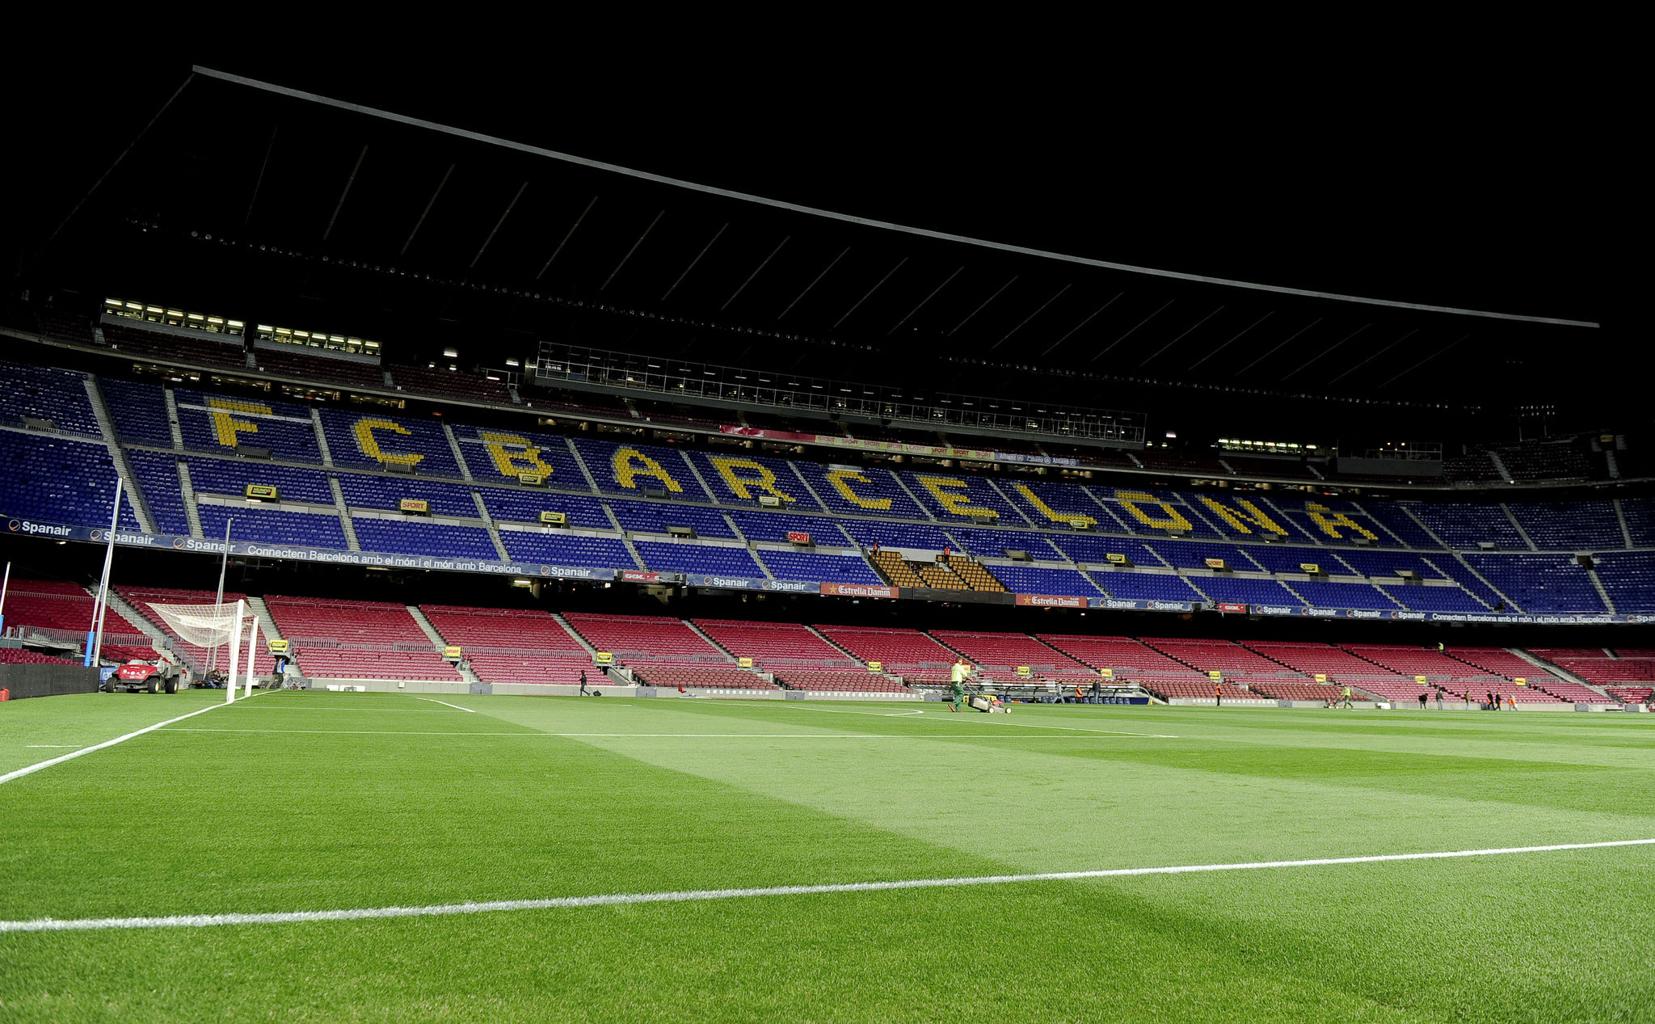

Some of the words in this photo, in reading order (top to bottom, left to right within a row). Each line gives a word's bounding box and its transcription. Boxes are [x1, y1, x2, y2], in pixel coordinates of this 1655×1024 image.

[479, 431, 1378, 542] BARCELONA
[402, 500, 425, 509] SPORT
[22, 521, 71, 536] Spanair
[789, 532, 808, 542] SPORT
[186, 540, 236, 551] Spanar
[247, 546, 306, 559] Connectem
[309, 550, 358, 563] Barcelona
[361, 555, 382, 564] amb
[385, 556, 394, 565] el
[395, 557, 416, 566] món
[424, 558, 432, 568] el
[434, 559, 453, 569] món
[455, 561, 476, 570] amb
[478, 562, 522, 573] Barcelona
[551, 566, 590, 577] Spanair
[713, 578, 749, 587] Spanair
[771, 581, 805, 591] Spanair
[838, 585, 866, 596] Estrella
[868, 587, 891, 597] Damm
[1032, 597, 1057, 605] Estrella
[1058, 598, 1079, 606] Damm
[1107, 600, 1136, 608] Spanair
[1154, 602, 1183, 610] Spanair
[1264, 606, 1291, 614] Spanair
[1309, 608, 1336, 617] Spanair
[1354, 610, 1381, 618] Spanair
[1398, 611, 1425, 620] Spanair
